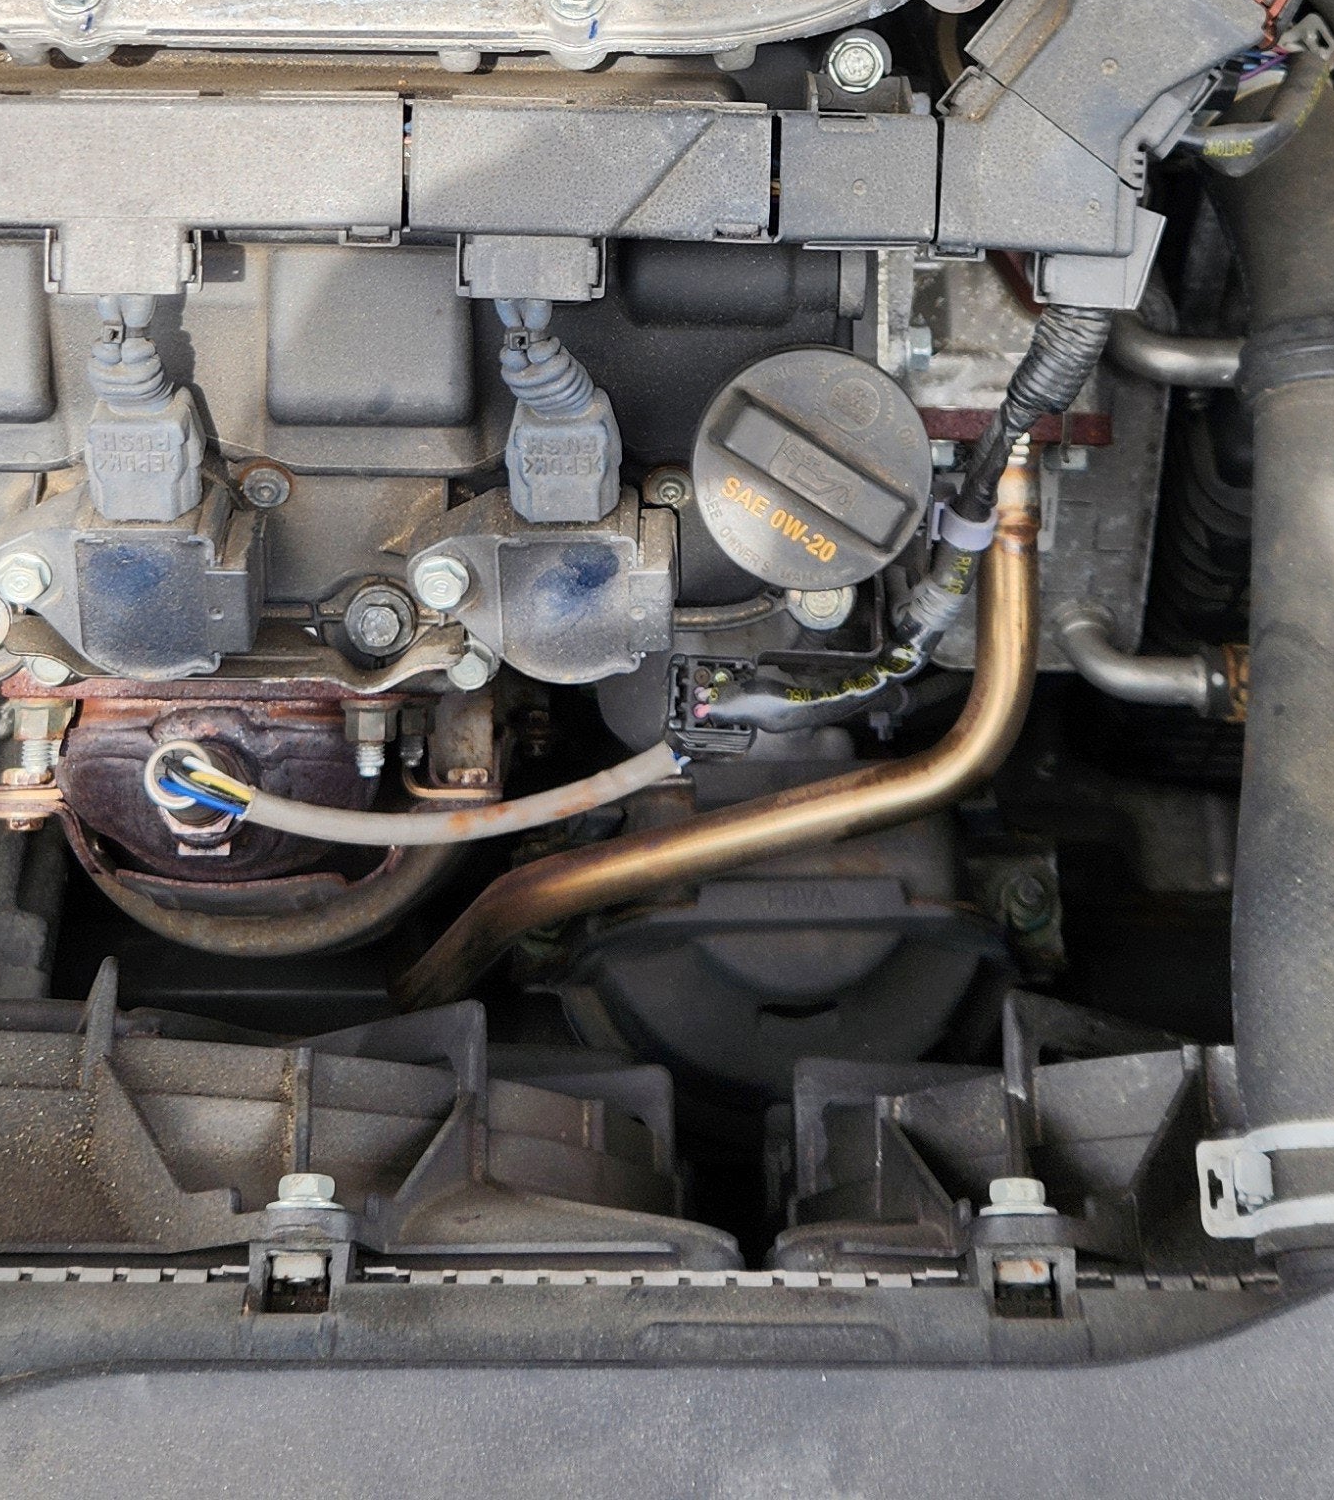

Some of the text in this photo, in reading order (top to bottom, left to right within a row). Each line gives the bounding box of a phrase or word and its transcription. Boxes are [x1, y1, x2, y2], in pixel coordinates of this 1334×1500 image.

[101, 431, 171, 452] PUSH
[527, 436, 598, 455] PUSH
[722, 475, 838, 563] SAE 0W-20
